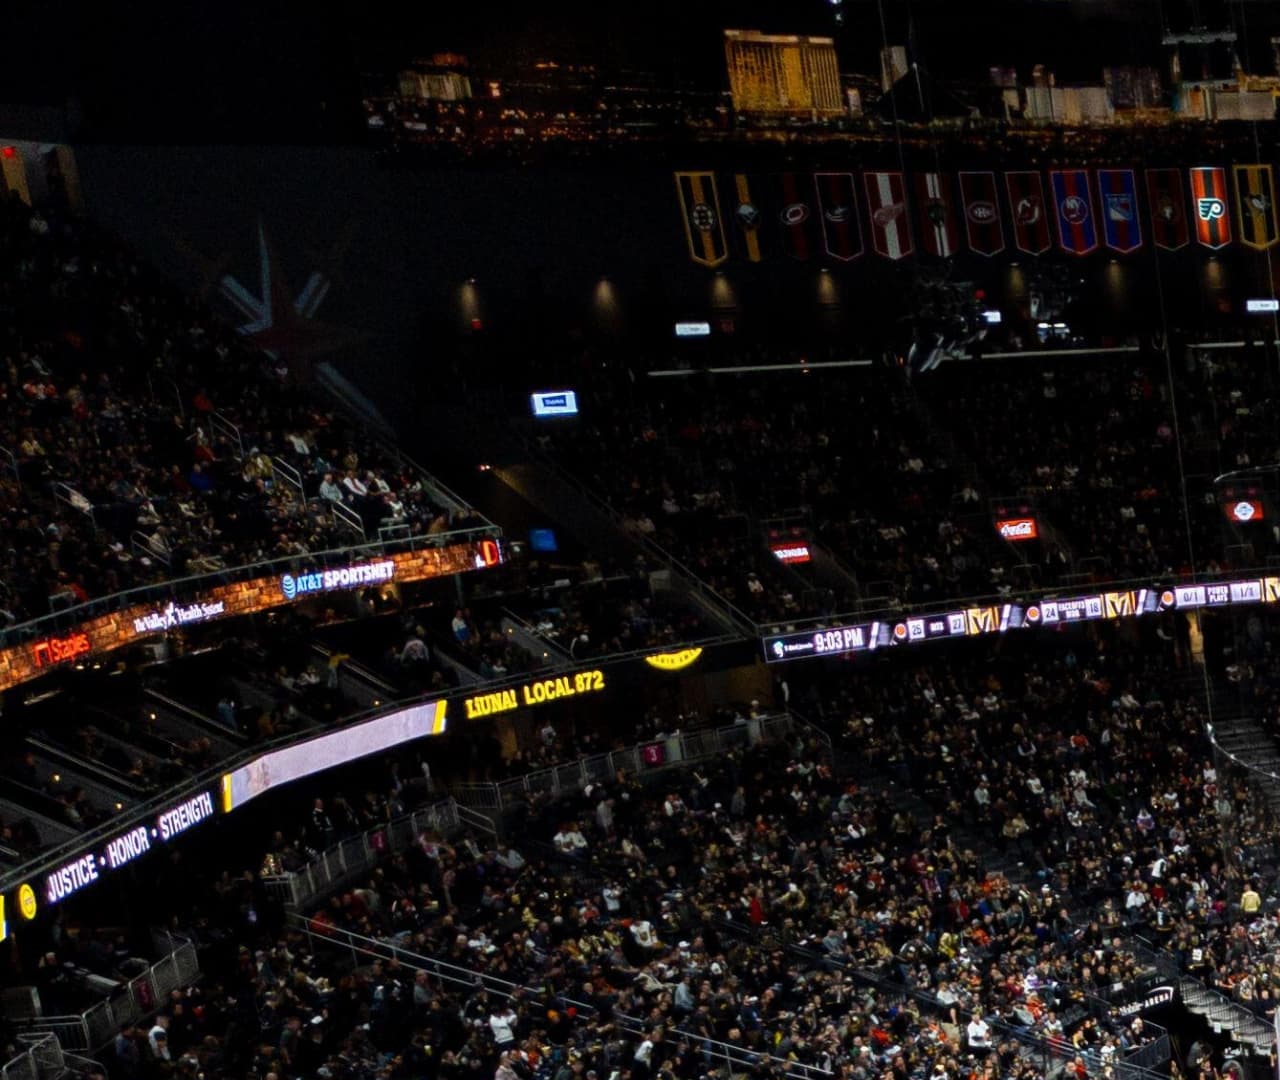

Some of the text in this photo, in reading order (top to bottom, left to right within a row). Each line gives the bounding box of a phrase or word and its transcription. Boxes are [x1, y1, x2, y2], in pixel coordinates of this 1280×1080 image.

[297, 561, 394, 592] AT&T SPORTSNET
[1045, 606, 1056, 619] 24
[1089, 600, 1099, 613] 18
[51, 633, 89, 660] Staples
[815, 633, 843, 651] 9:03
[844, 628, 862, 647] PM
[524, 676, 575, 704] LOCAL
[575, 670, 604, 694] 872
[48, 792, 213, 901] JUSTICE HONOR STRENGTH
